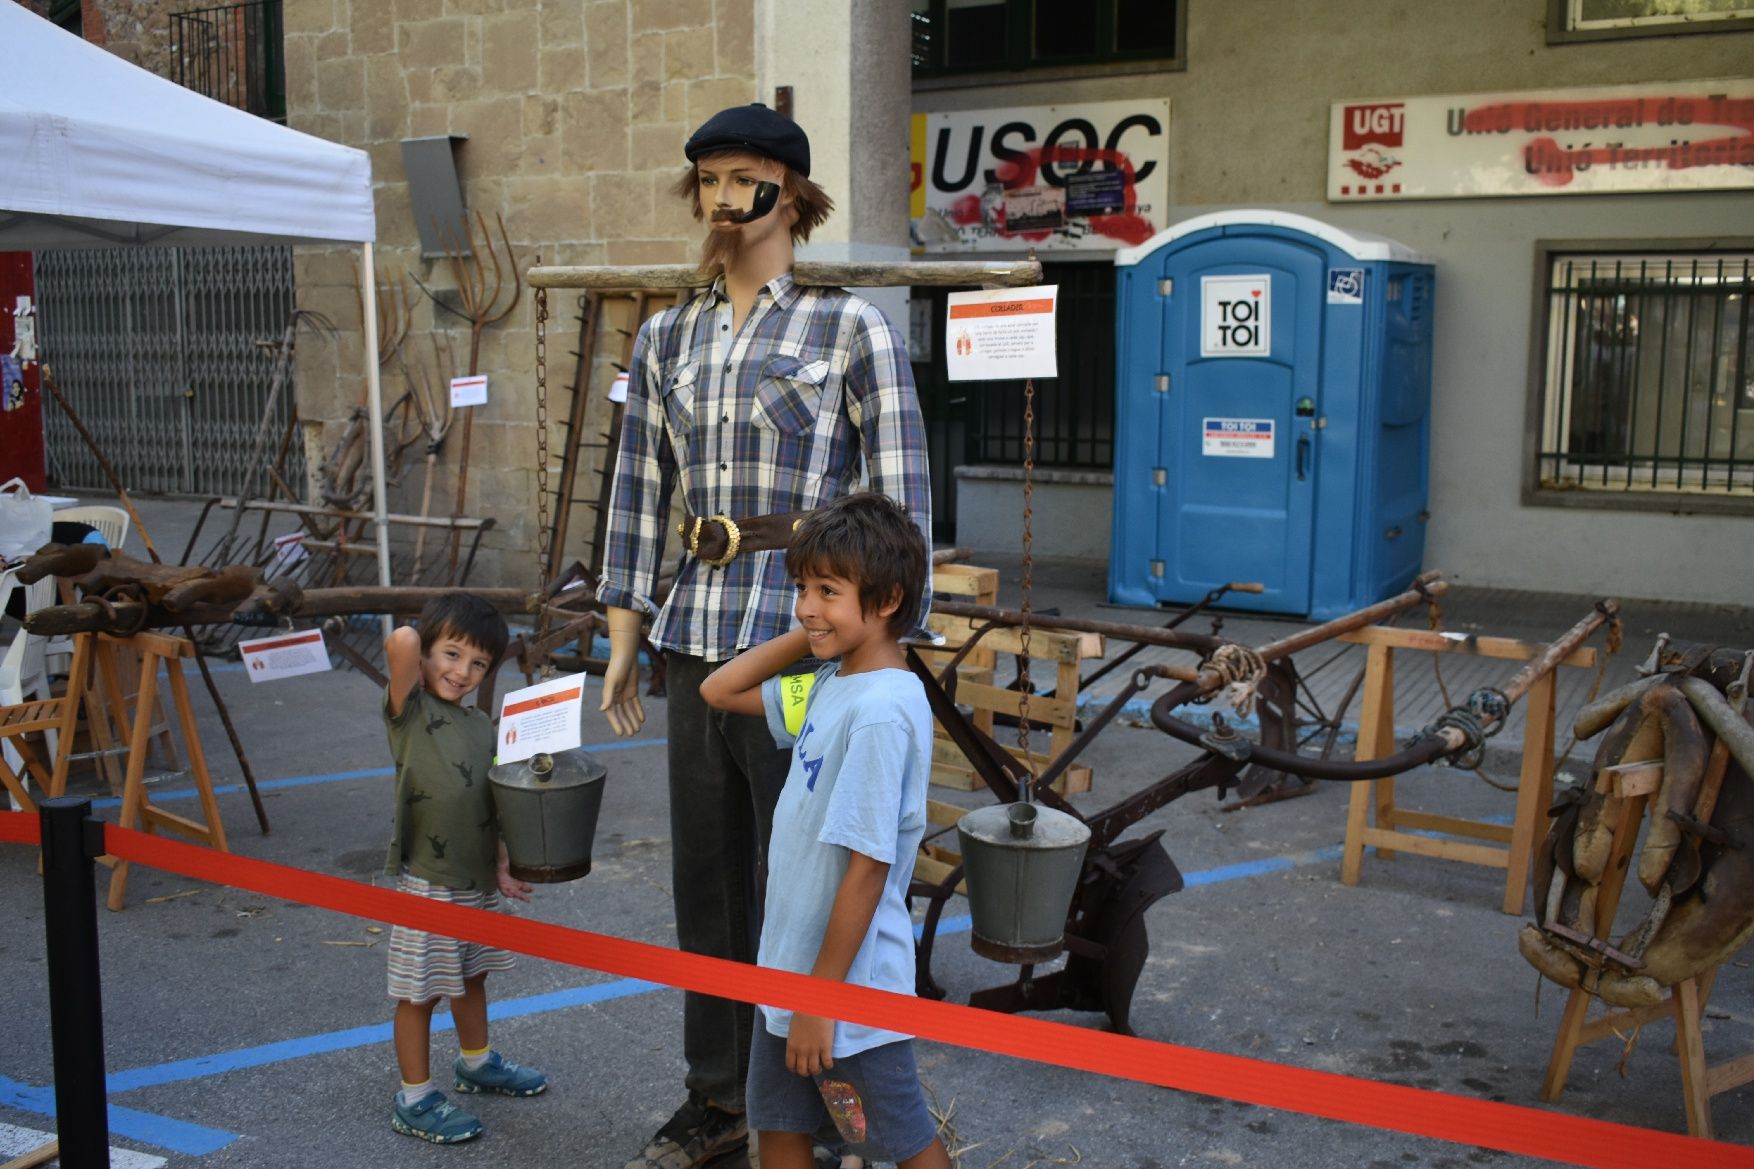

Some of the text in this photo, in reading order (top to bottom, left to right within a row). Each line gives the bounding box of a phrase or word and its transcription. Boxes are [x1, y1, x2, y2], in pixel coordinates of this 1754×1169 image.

[1353, 107, 1404, 135] UGT
[1524, 98, 1643, 132] General
[1657, 97, 1694, 126] de
[931, 114, 1162, 193] USOC
[1525, 142, 1592, 174] Unió
[1218, 300, 1259, 322] TOI
[1218, 325, 1259, 346] TOI
